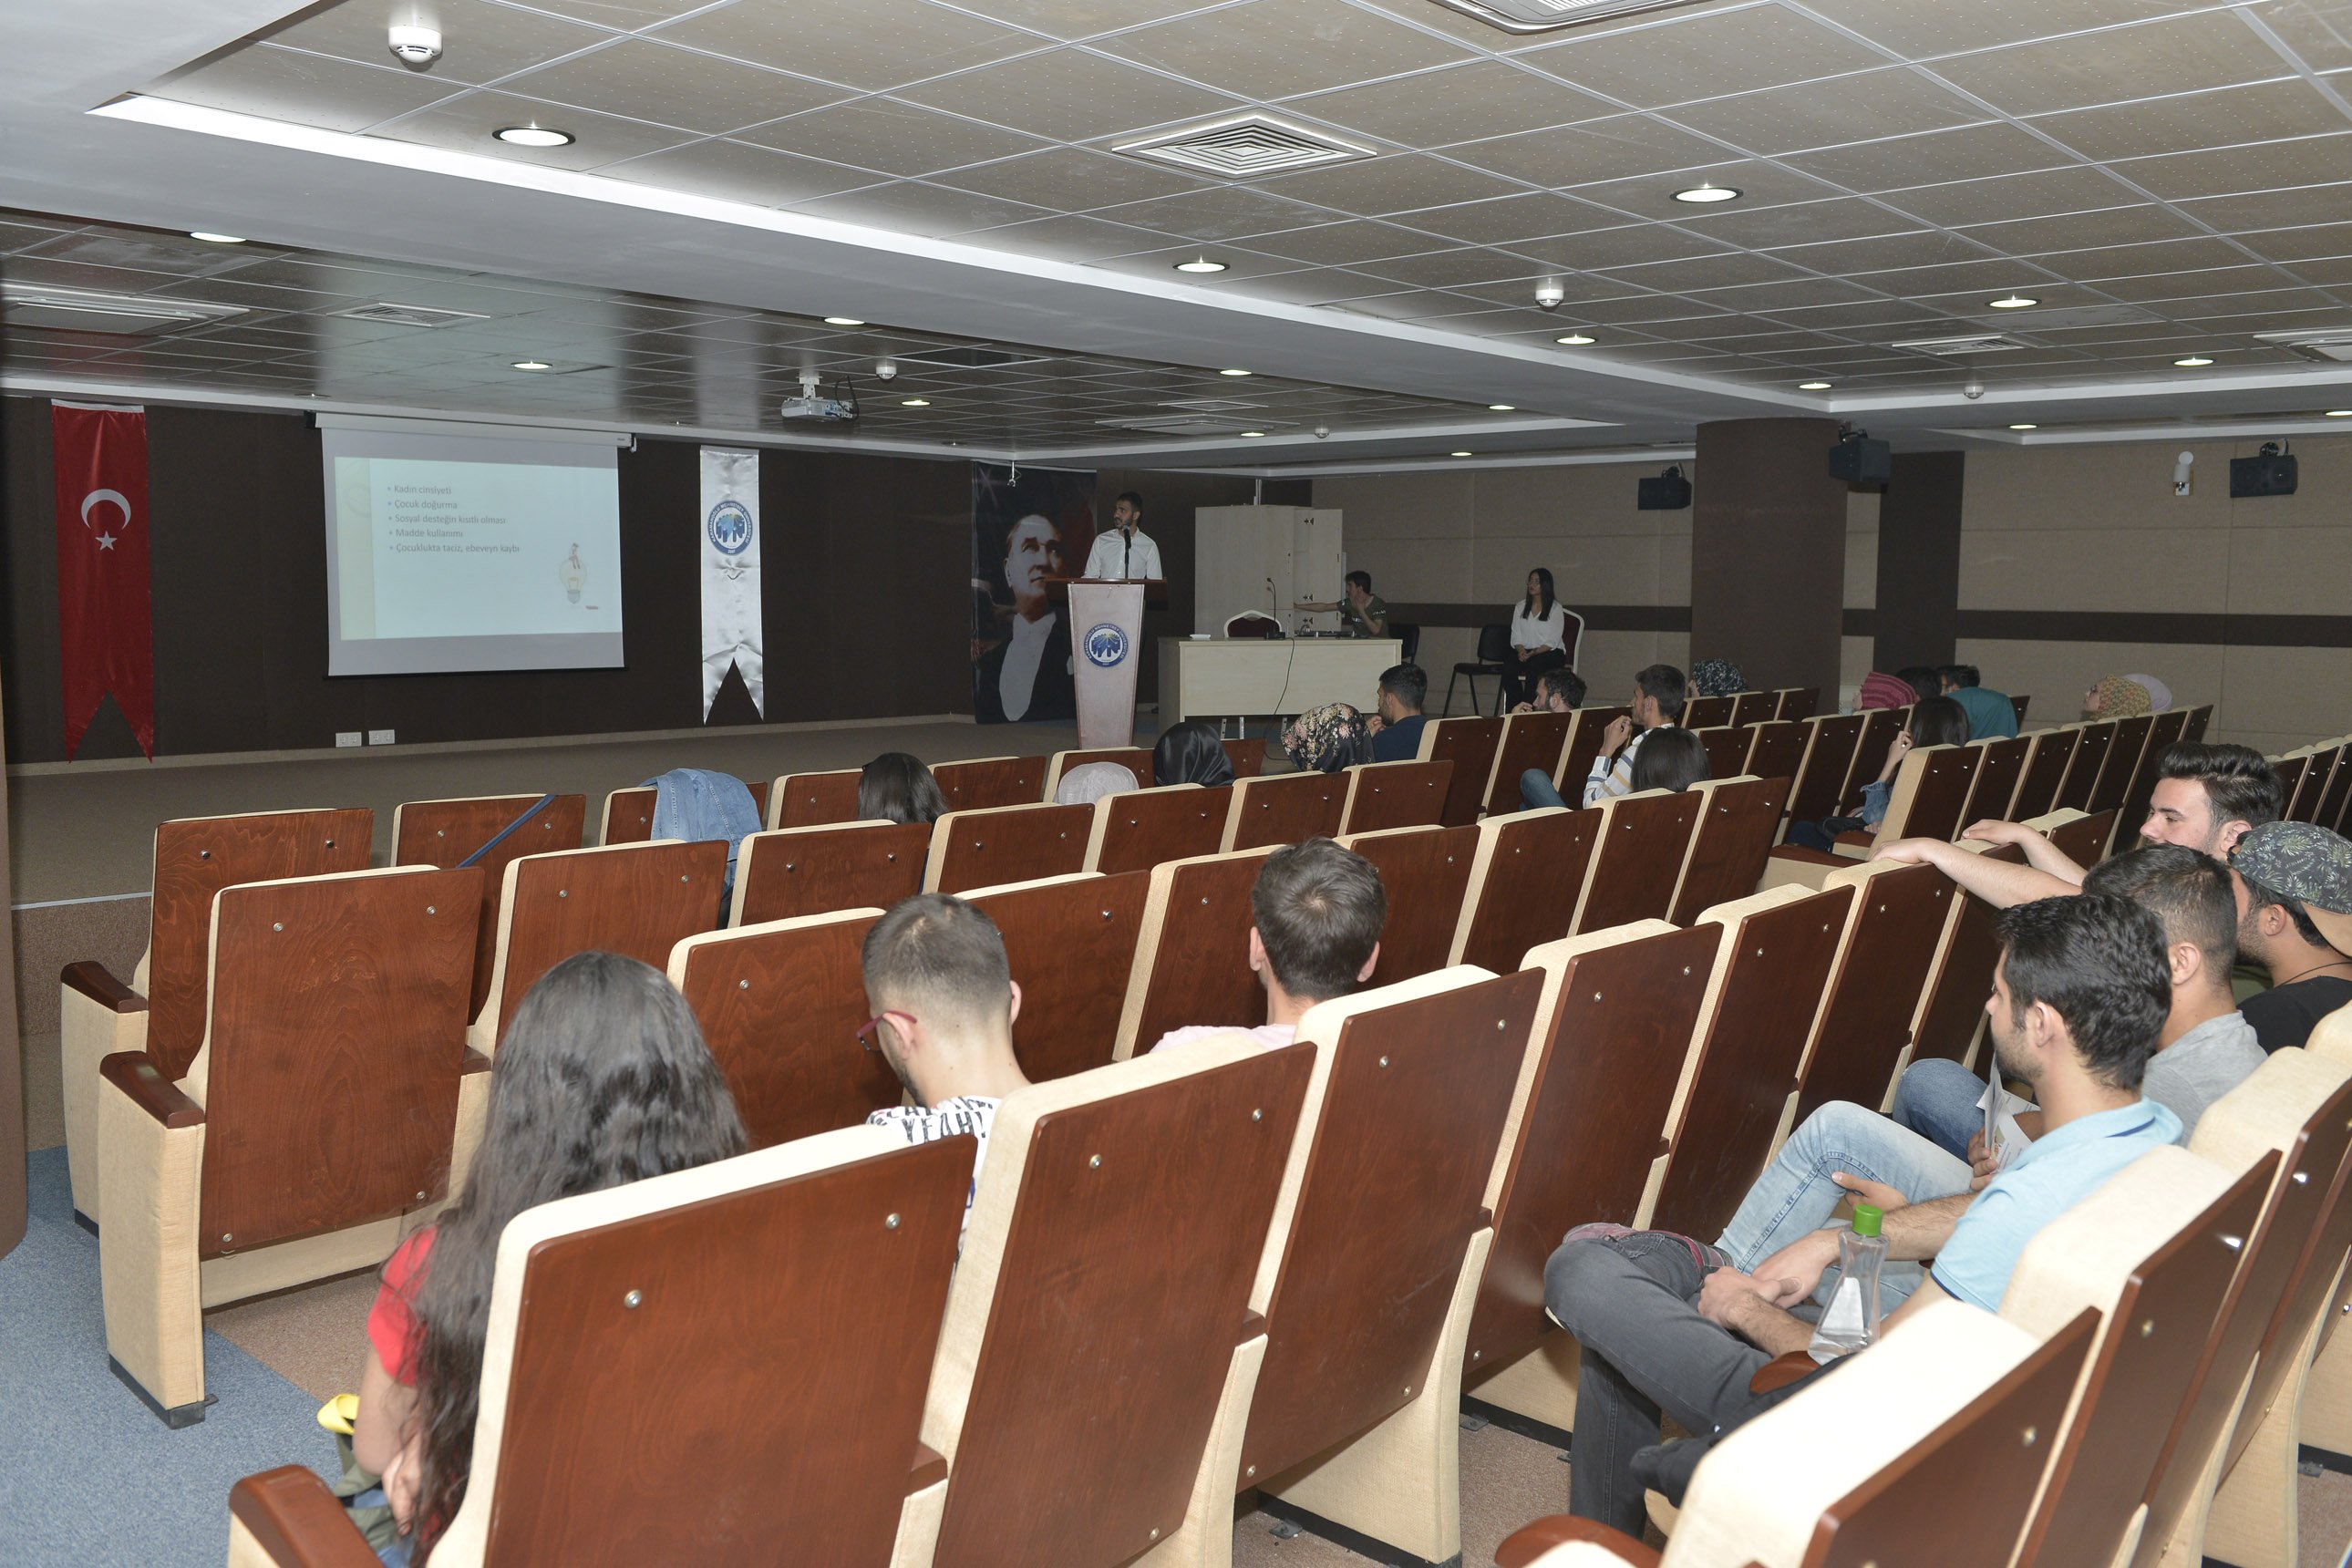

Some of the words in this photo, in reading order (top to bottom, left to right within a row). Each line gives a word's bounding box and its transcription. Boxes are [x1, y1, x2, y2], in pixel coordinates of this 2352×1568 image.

[394, 485, 417, 493] Kadın
[418, 486, 451, 495] cinsiyeti
[394, 500, 418, 509] Çocuk
[421, 500, 458, 511] doğurma
[395, 514, 420, 523] Sosyal
[422, 514, 456, 525] desteğin
[459, 516, 479, 524] kısıtlı
[396, 529, 424, 537] Madde
[427, 529, 463, 538] kullanımı
[396, 543, 440, 553] Çocuklukta
[466, 544, 499, 553] ebeveyn
[500, 544, 520, 553] kaybı
